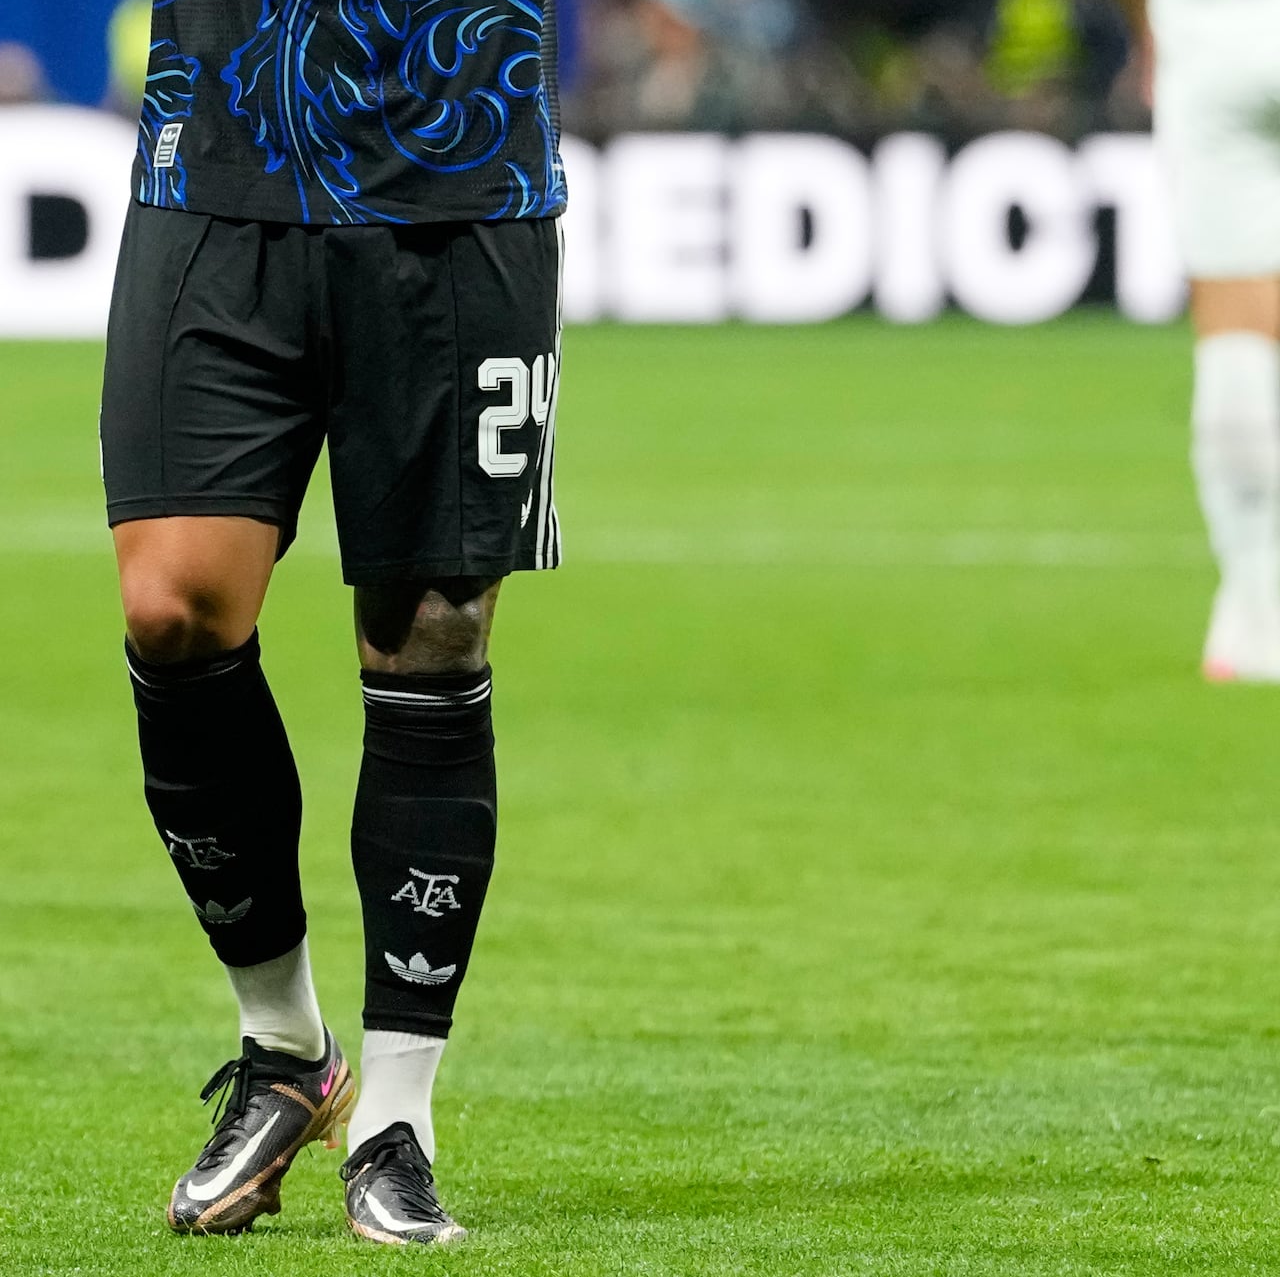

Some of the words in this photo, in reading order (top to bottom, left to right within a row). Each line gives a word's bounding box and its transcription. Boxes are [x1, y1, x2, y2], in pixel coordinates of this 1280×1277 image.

[562, 129, 1192, 325] EDICT
[478, 351, 556, 478] 24
[390, 867, 461, 917] AFA
